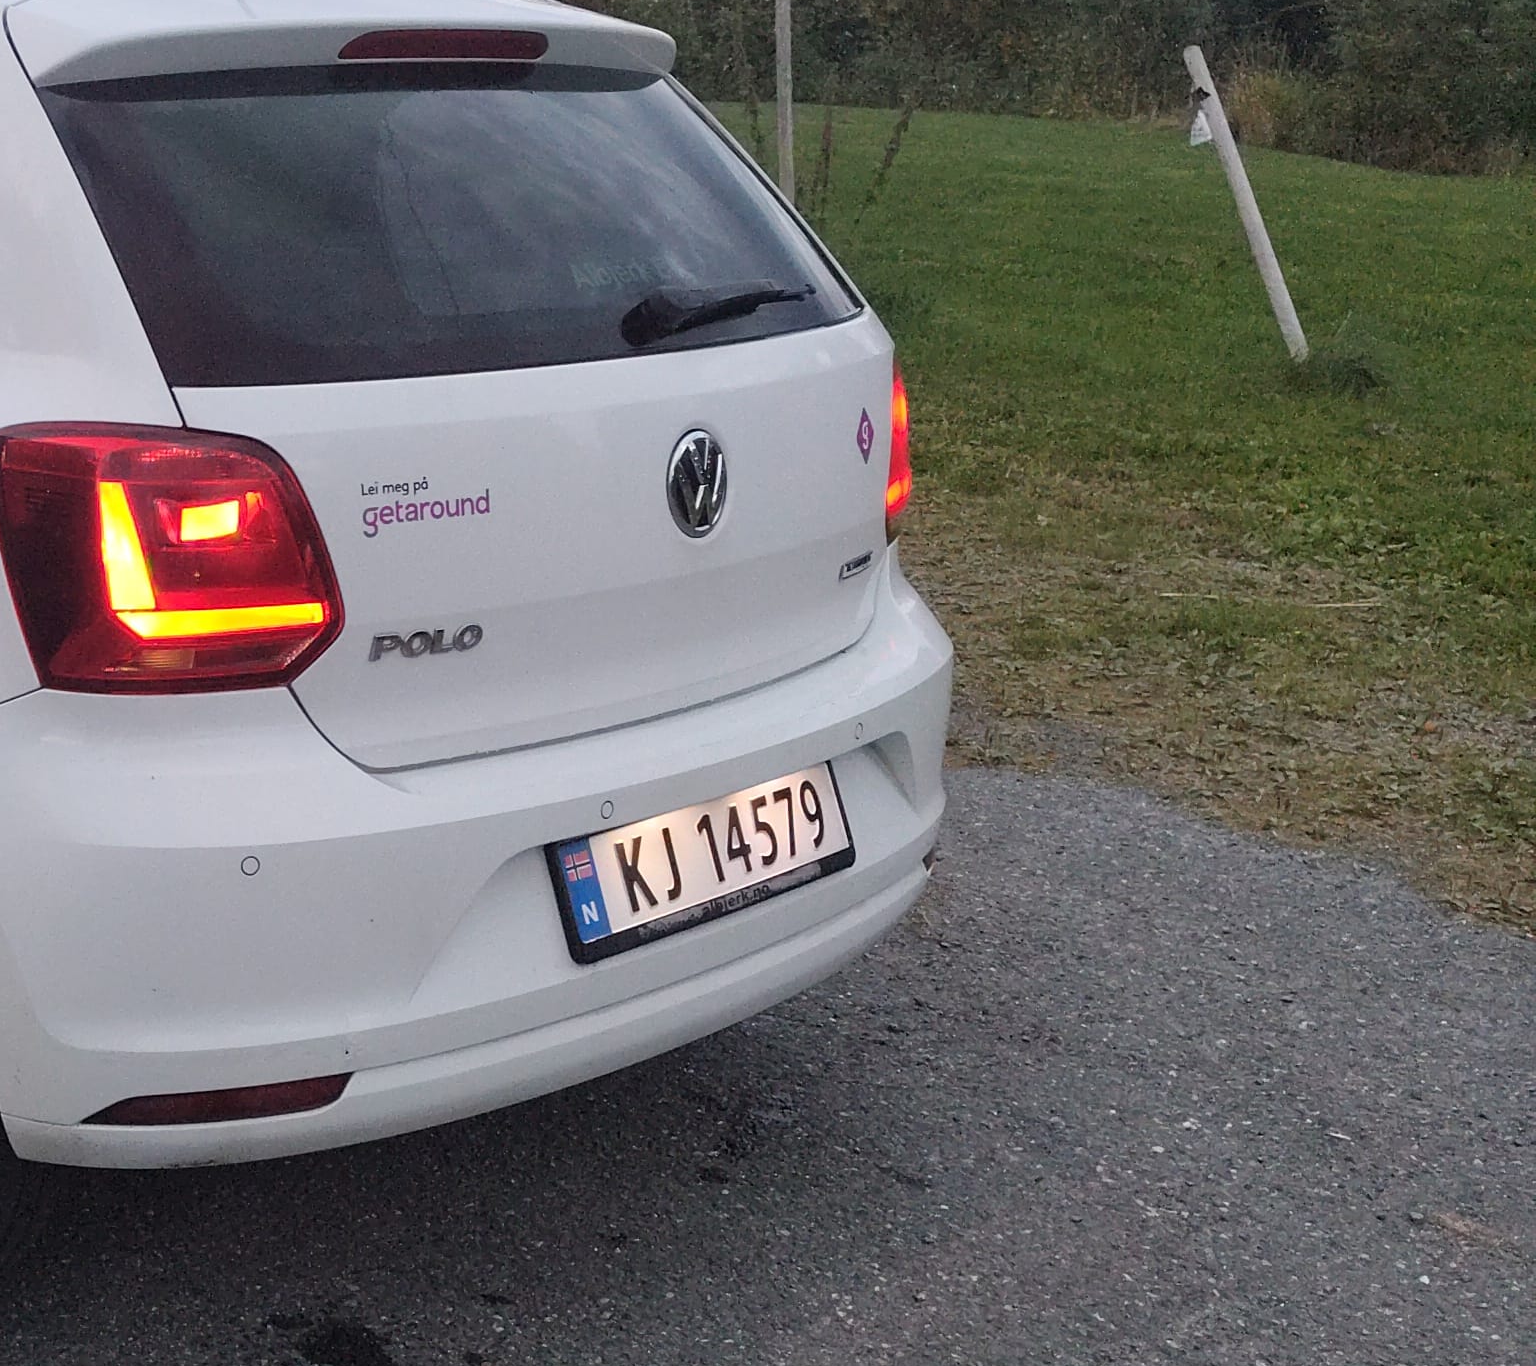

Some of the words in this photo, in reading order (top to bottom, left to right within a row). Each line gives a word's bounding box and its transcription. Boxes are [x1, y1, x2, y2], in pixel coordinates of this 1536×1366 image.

[360, 481, 379, 497] Lei
[382, 481, 410, 496] meg
[413, 476, 429, 496] på
[362, 488, 491, 539] getaround
[368, 624, 484, 663] POLO
[613, 826, 682, 913] KJ
[695, 779, 825, 883] 14579
[580, 900, 600, 926] N
